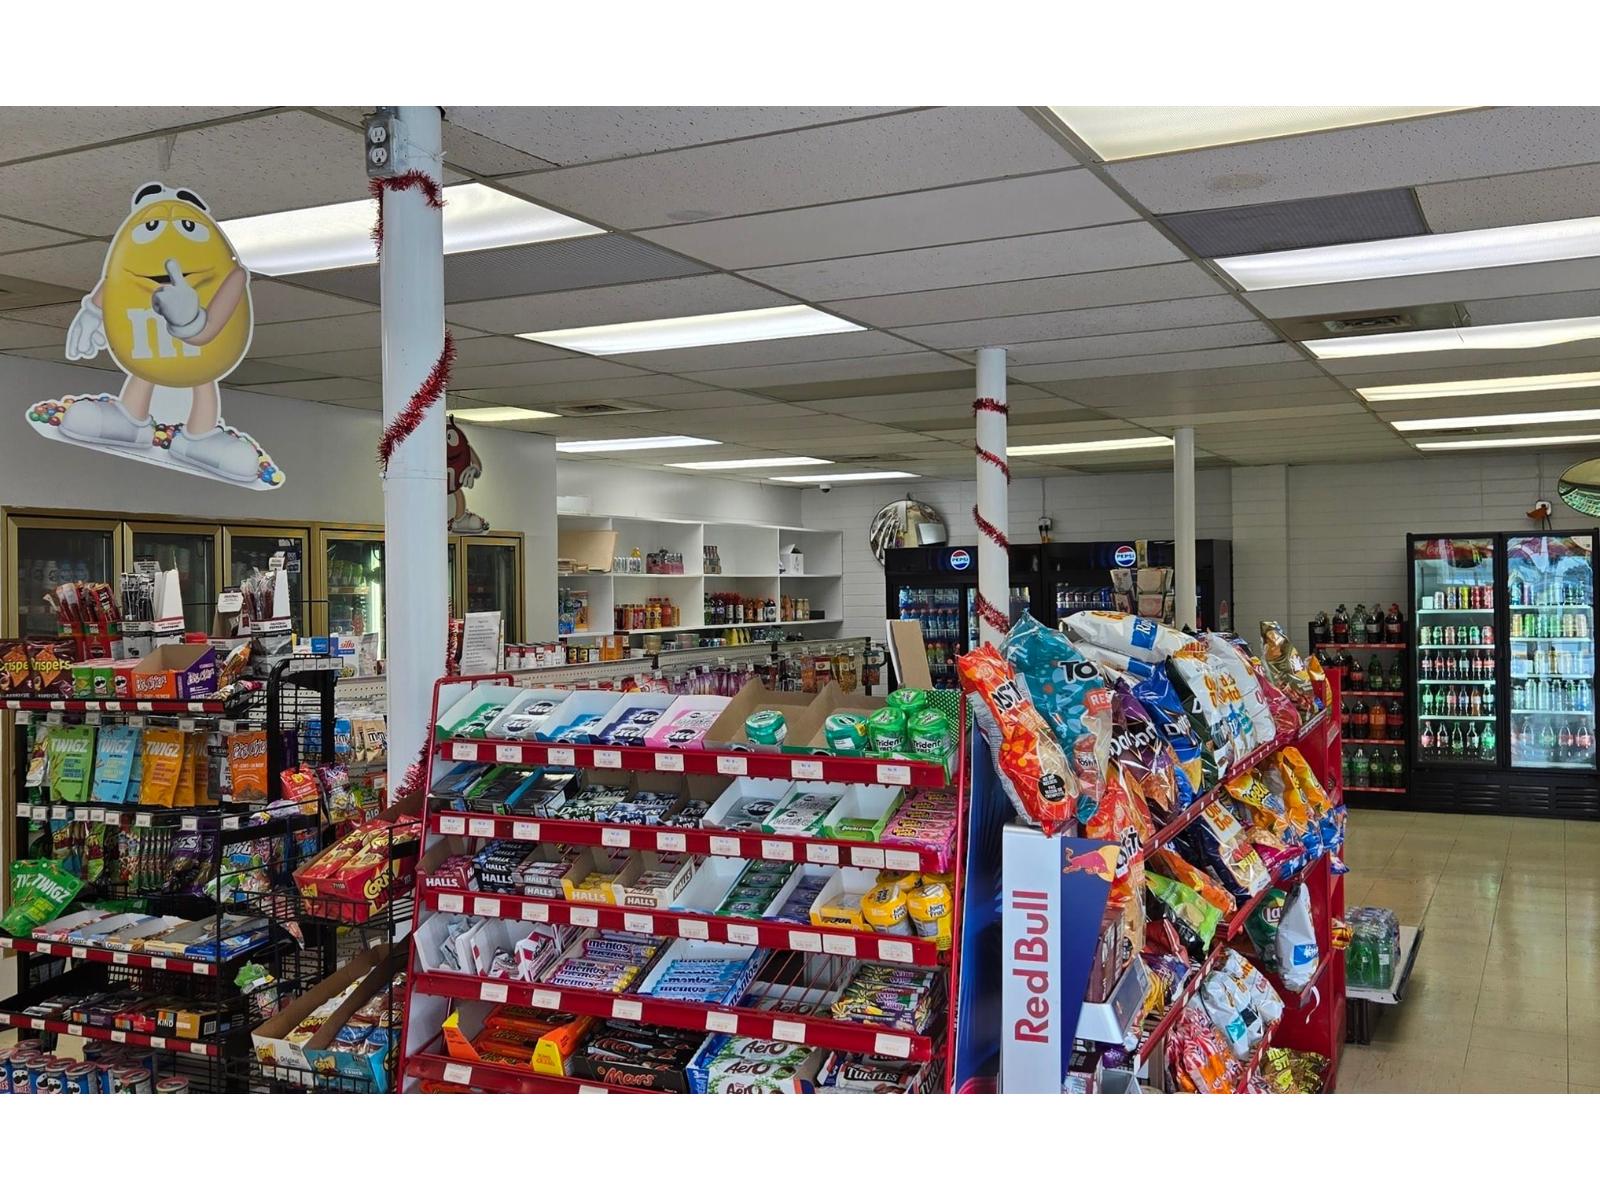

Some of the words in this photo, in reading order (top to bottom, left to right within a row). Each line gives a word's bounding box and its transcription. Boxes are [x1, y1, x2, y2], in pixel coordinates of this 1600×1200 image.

[50, 738, 89, 754] TWIGZ
[97, 738, 129, 753] TWIGZ
[146, 741, 179, 757] TWIGZ
[875, 737, 904, 749] Trident
[912, 740, 942, 750] Trident
[486, 863, 507, 871] HALLS
[426, 877, 458, 888] HALLS
[481, 873, 513, 885] HALLS
[674, 870, 692, 898] HALLS
[32, 872, 70, 904] TWIGZ
[527, 887, 554, 896] HALLS
[572, 891, 607, 903] HALLS
[626, 897, 656, 907] HALLS
[1012, 890, 1049, 963] Bull
[588, 939, 629, 952] mentos
[564, 964, 606, 975] mentos
[553, 977, 595, 988] mentos
[1012, 969, 1049, 1044] Red
[157, 1018, 174, 1028] KIND
[740, 1040, 788, 1055] Aero
[723, 1061, 771, 1075] Aero
[847, 1066, 898, 1082] TURTLES
[604, 1068, 656, 1087] Mars
